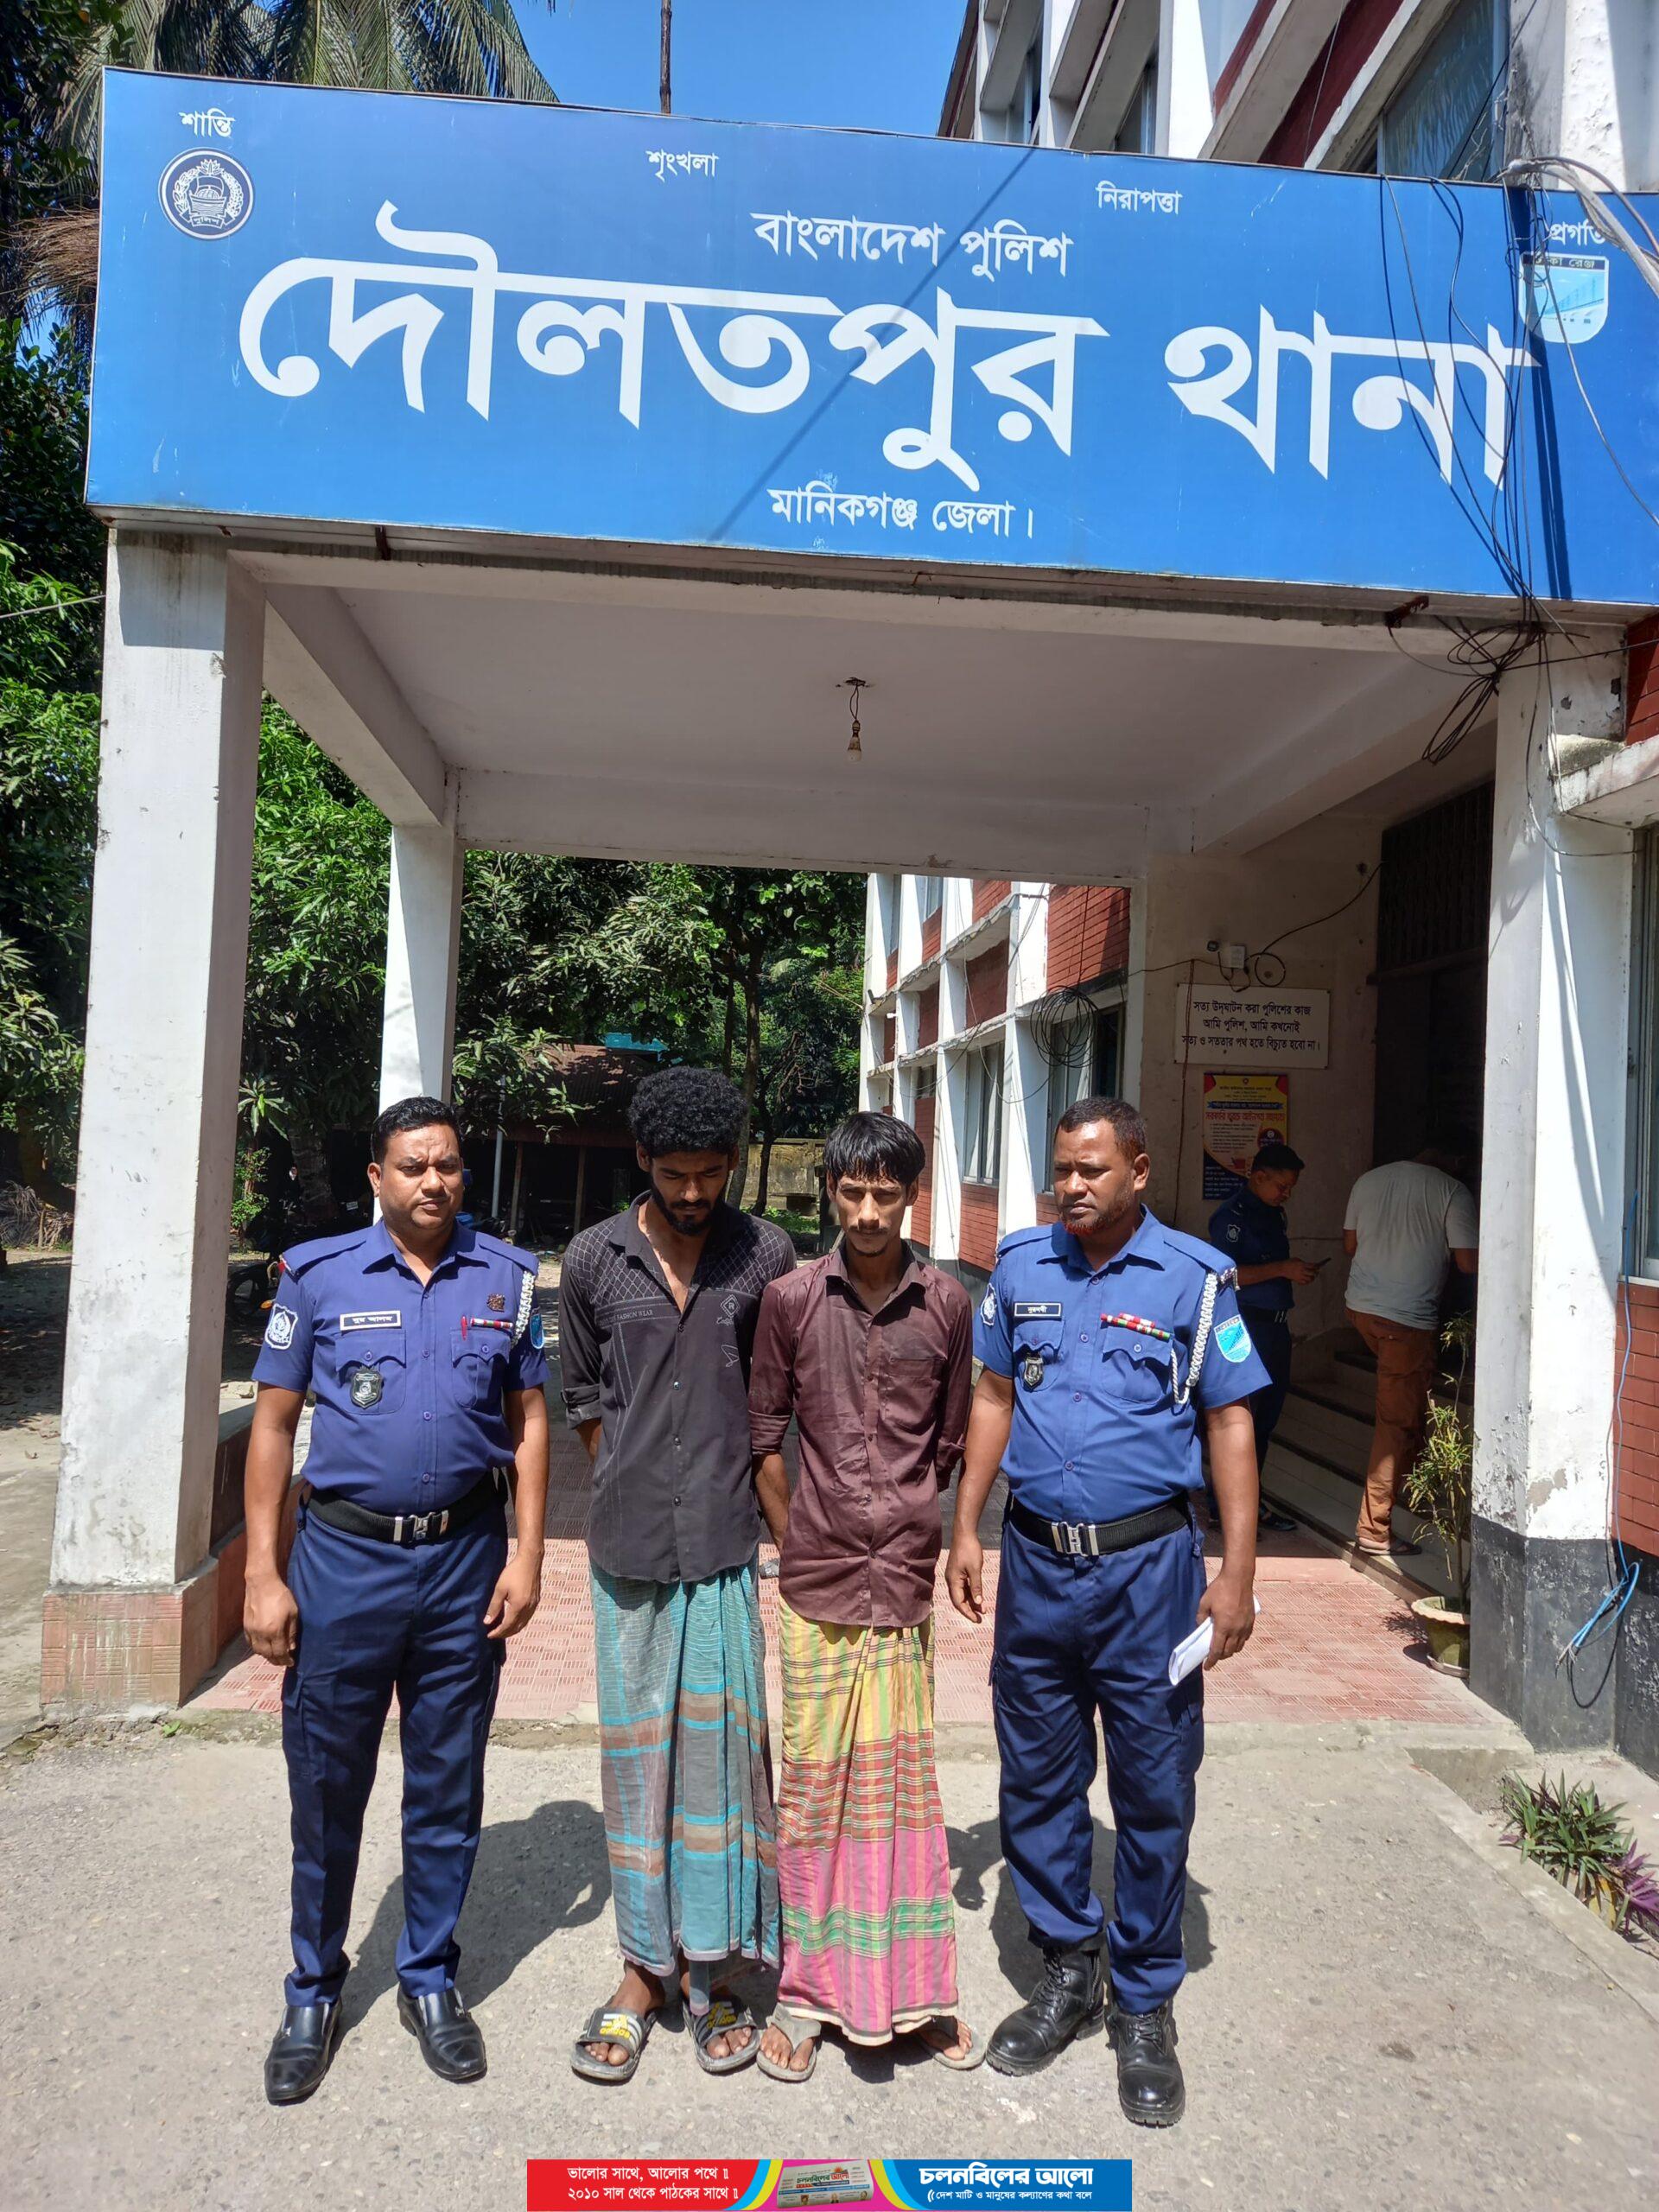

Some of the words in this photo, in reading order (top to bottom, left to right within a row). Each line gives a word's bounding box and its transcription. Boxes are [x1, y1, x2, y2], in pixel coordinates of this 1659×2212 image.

[180, 107, 236, 137] শান্তি
[645, 149, 719, 182] শৃংখলা
[1096, 180, 1182, 214] নিরাপত্তা
[749, 210, 945, 265] বাংলাদেশ
[959, 219, 1074, 282] পুলিশ
[239, 200, 1110, 492] দৌলতপুর
[1163, 304, 1541, 491] থানা
[767, 481, 918, 531] মানিকগঞ্জ
[1193, 1001, 1209, 1012] সত্য
[1244, 1004, 1260, 1014] করা
[1262, 1001, 1291, 1015] পুলিশের
[1294, 1006, 1313, 1015] কাজ
[1203, 1016, 1221, 1029] আমি
[1249, 1019, 1268, 1030] আমি
[1271, 1020, 1300, 1033] কখনোই
[1208, 1037, 1233, 1046] সততার
[1236, 1039, 1247, 1047] পথ
[1249, 1039, 1265, 1049] হতে
